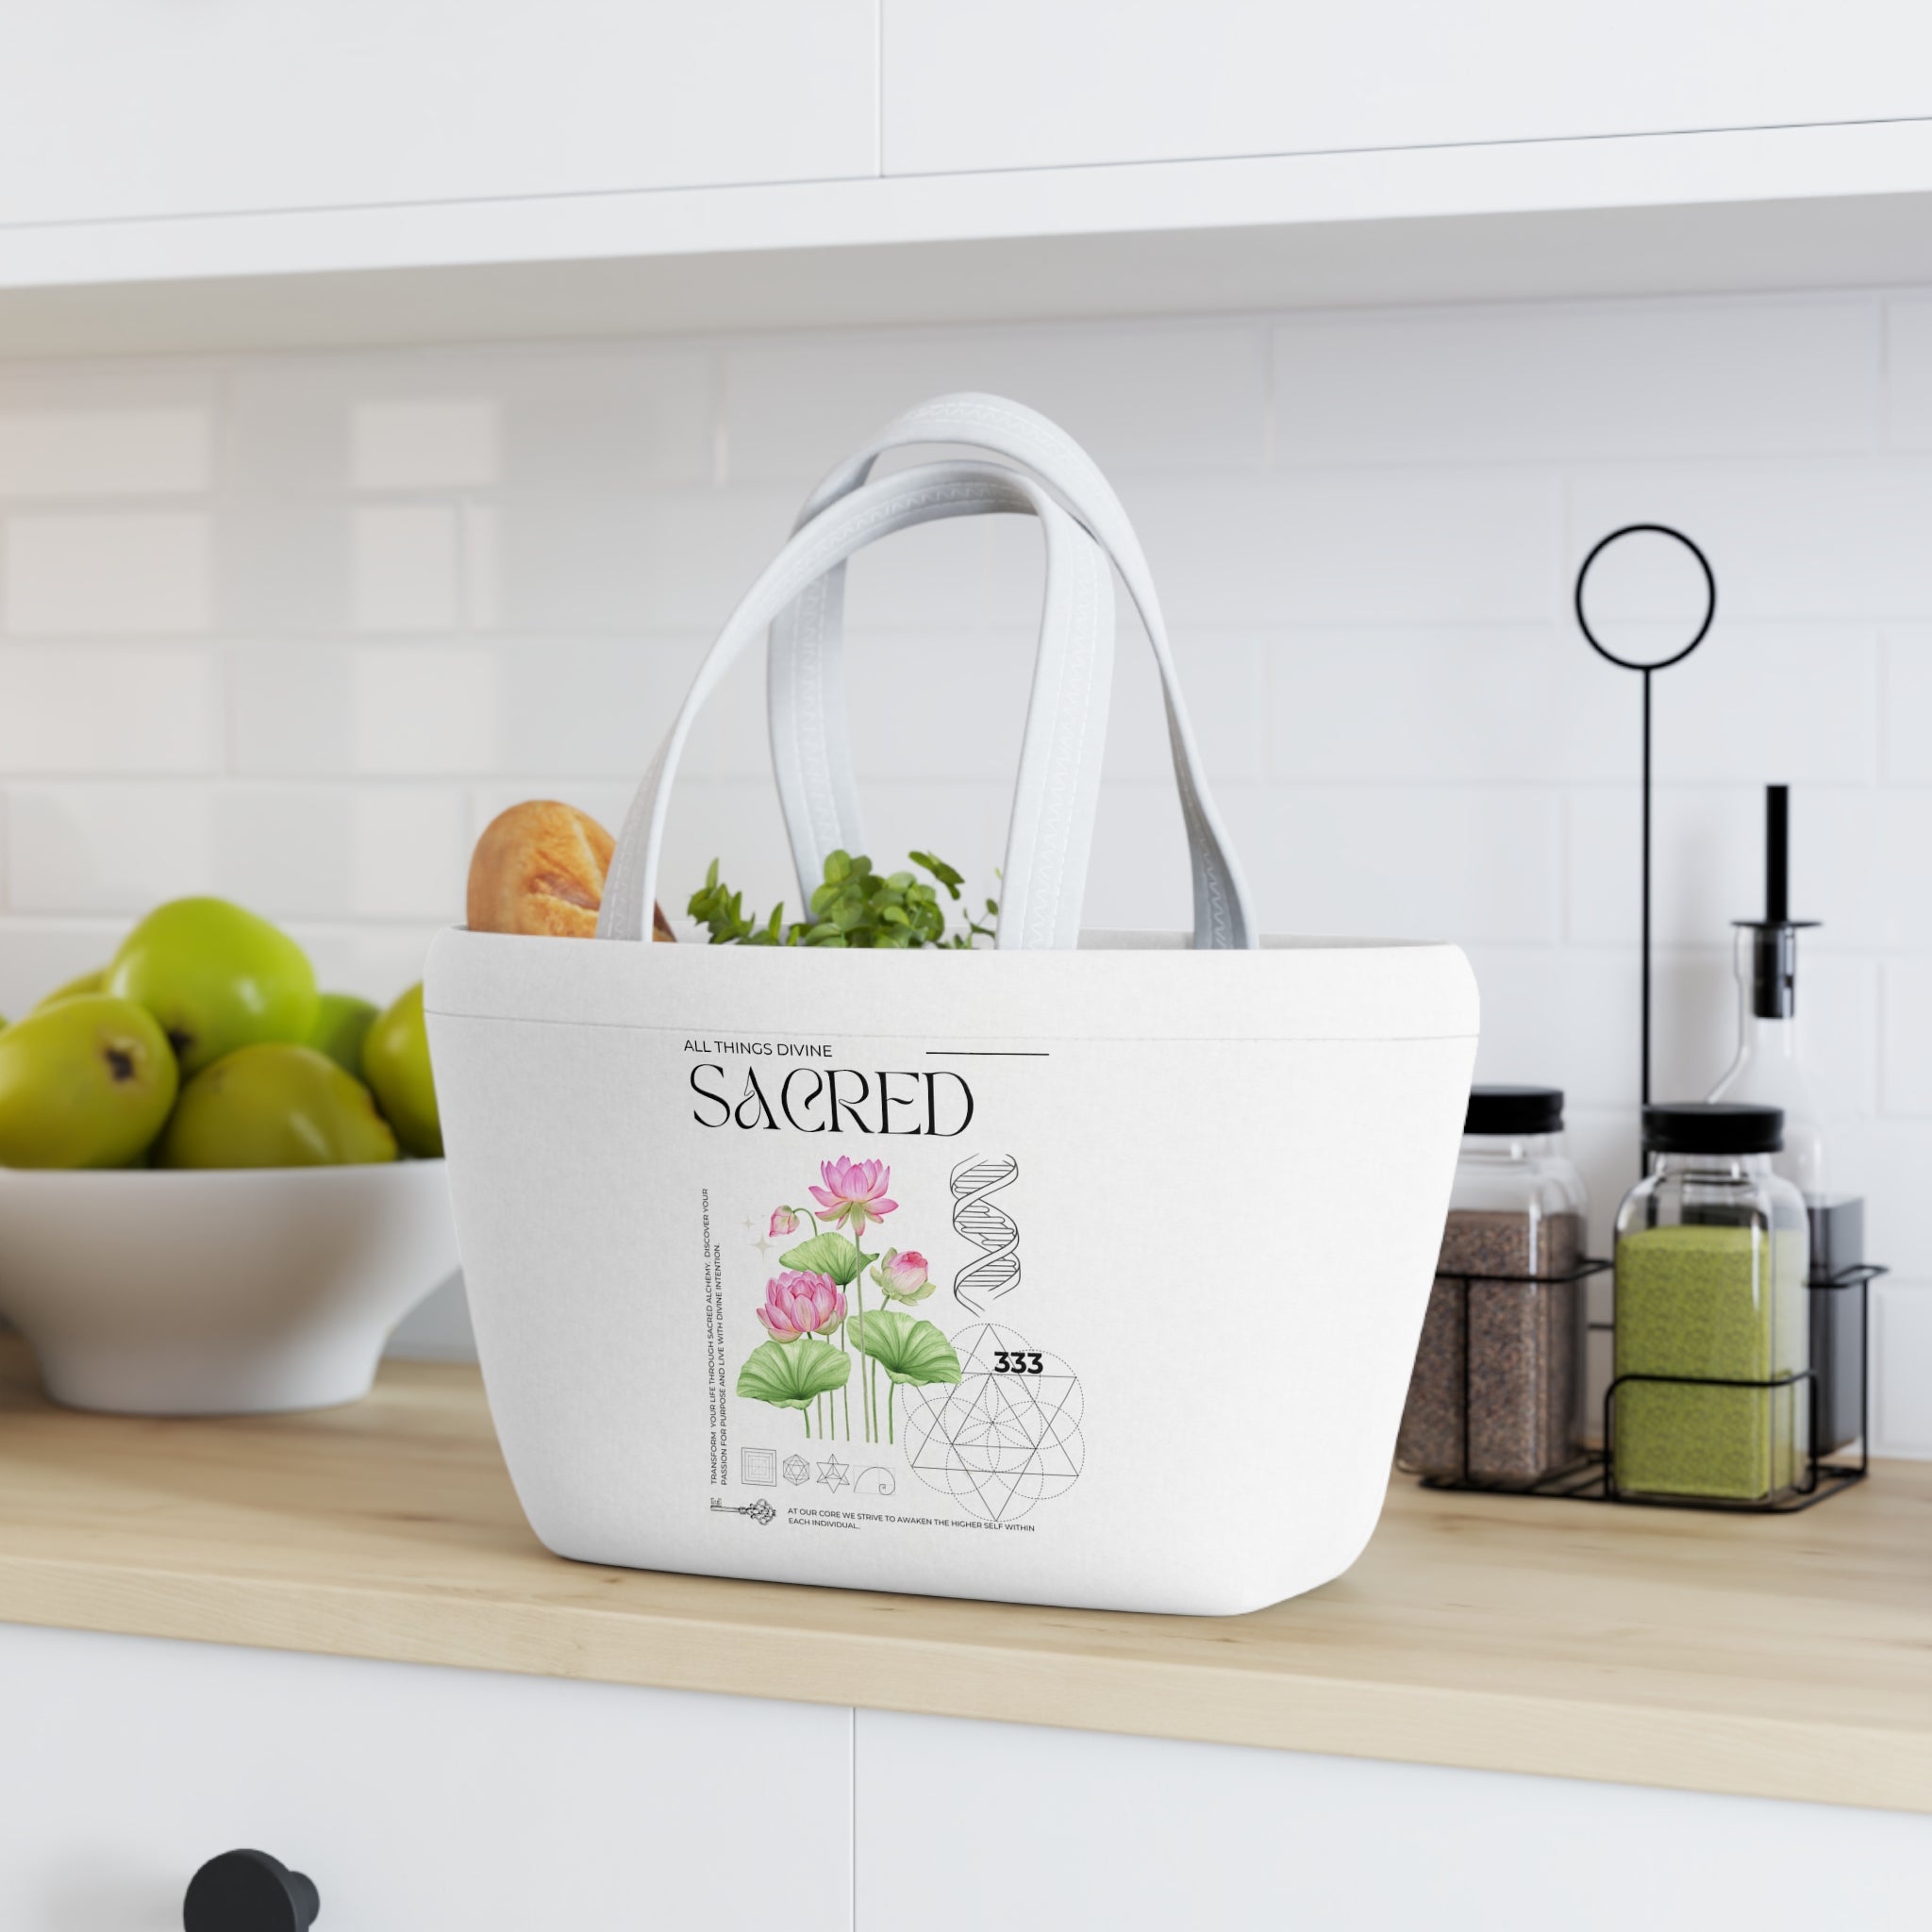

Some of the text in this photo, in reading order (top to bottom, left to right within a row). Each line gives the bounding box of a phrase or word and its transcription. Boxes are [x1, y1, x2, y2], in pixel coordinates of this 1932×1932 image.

[684, 1040, 833, 1058] ALL THINGS DIVINE
[690, 1063, 974, 1137] SACRED
[993, 1351, 1044, 1374] 333
[858, 1513, 883, 1522] STRIVE
[897, 1516, 932, 1524] AWAKEN
[1005, 1524, 1034, 1532] WITHIN
